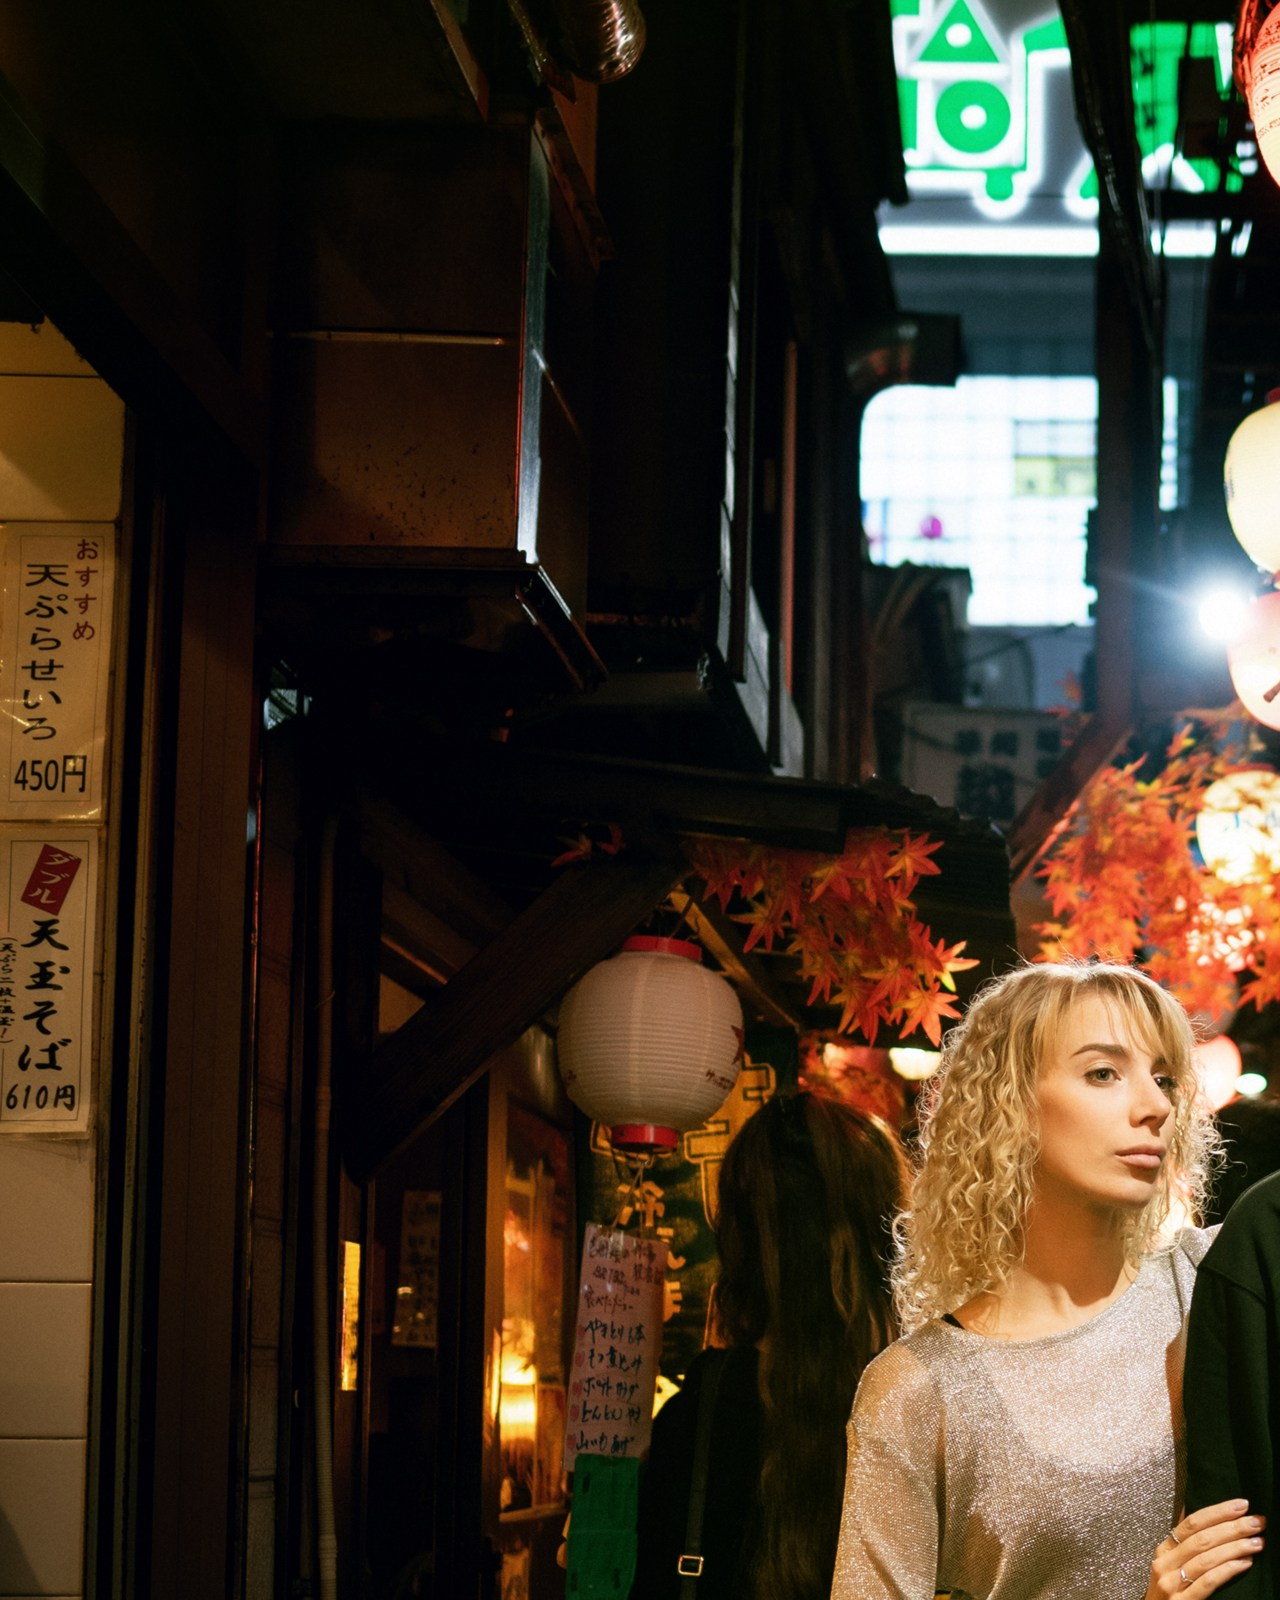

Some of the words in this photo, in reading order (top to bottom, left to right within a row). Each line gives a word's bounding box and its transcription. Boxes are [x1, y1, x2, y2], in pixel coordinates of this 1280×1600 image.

[73, 538, 98, 640] おすすめ
[22, 564, 69, 740] 天ぷらせいろ
[14, 755, 87, 793] 450円
[28, 852, 81, 904] ダブル
[18, 918, 72, 1071] 天玉そば
[6, 1083, 76, 1111] 610円
